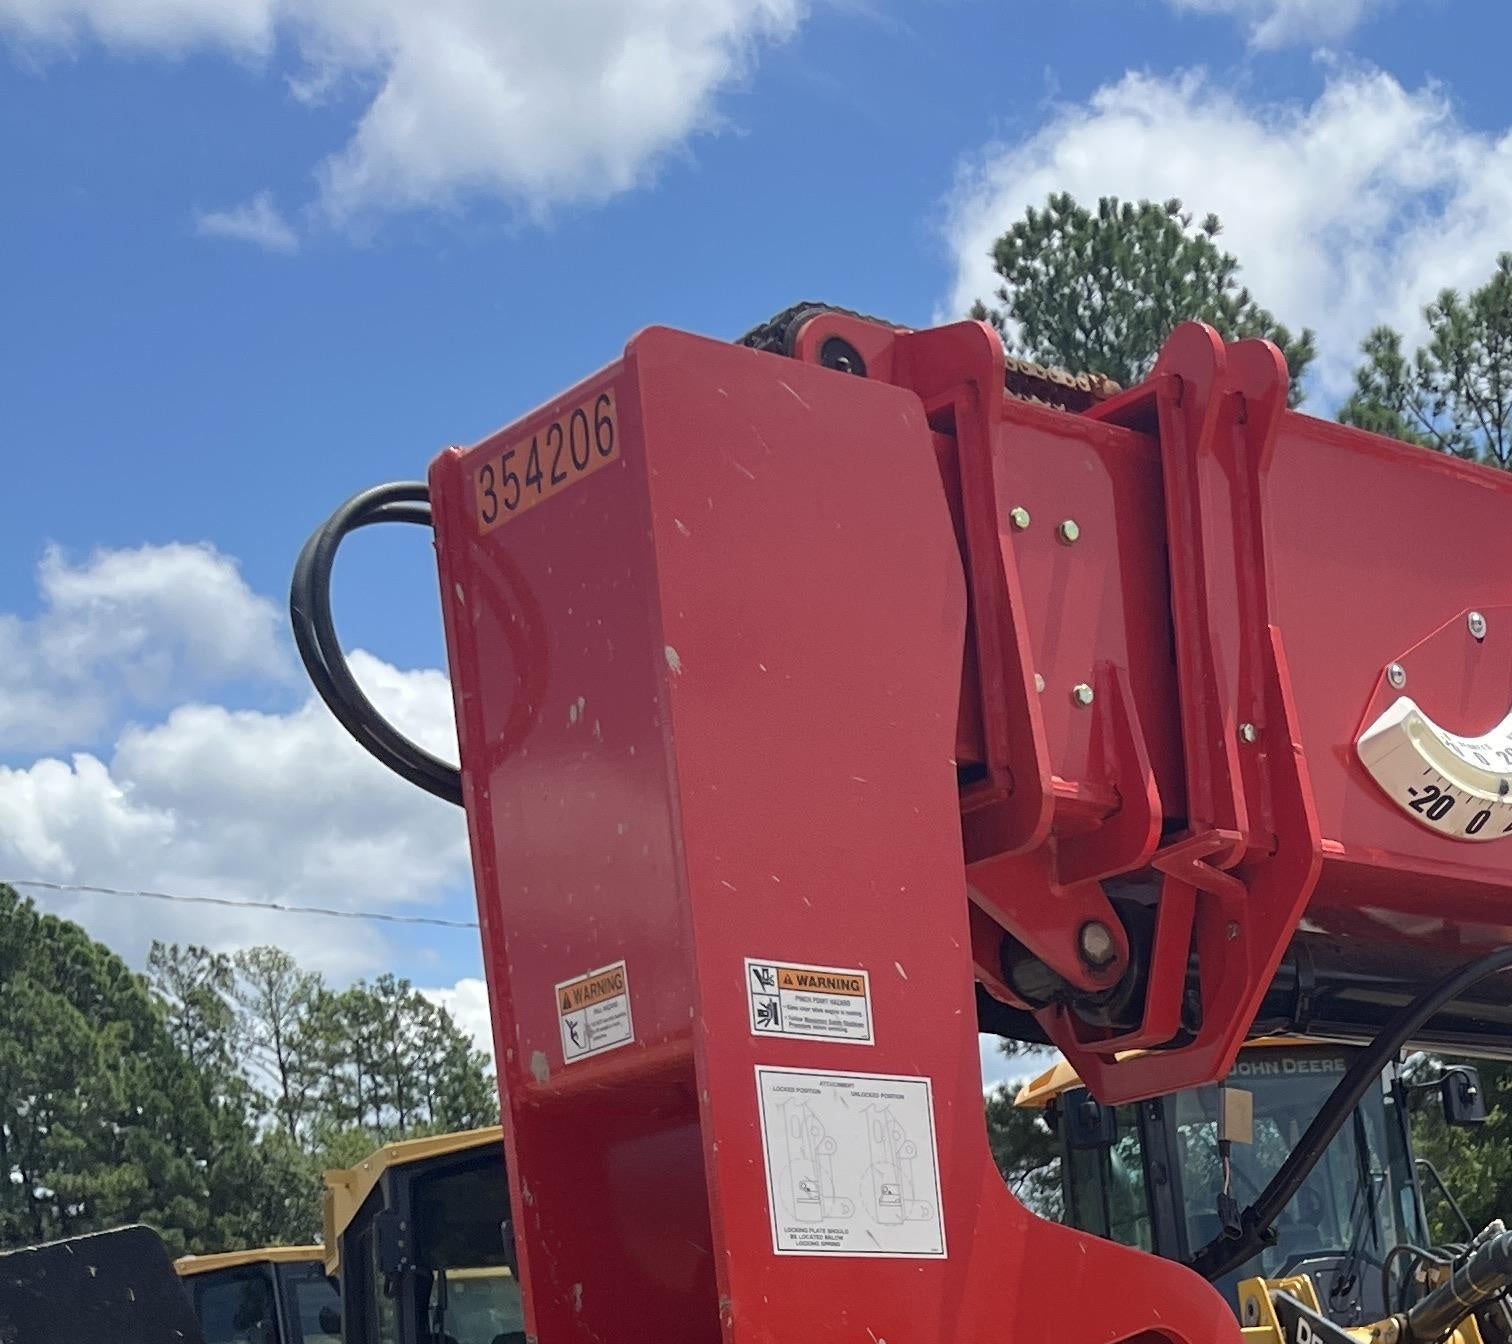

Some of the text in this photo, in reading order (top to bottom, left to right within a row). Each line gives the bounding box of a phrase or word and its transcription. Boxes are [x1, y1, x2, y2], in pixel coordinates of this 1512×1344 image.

[479, 393, 614, 524] 354206
[1407, 784, 1456, 821] -20
[1465, 809, 1492, 835] 0
[572, 973, 624, 1005] WARNING
[796, 974, 860, 992] WARNING
[1229, 1058, 1346, 1076] JOHN DEERE
